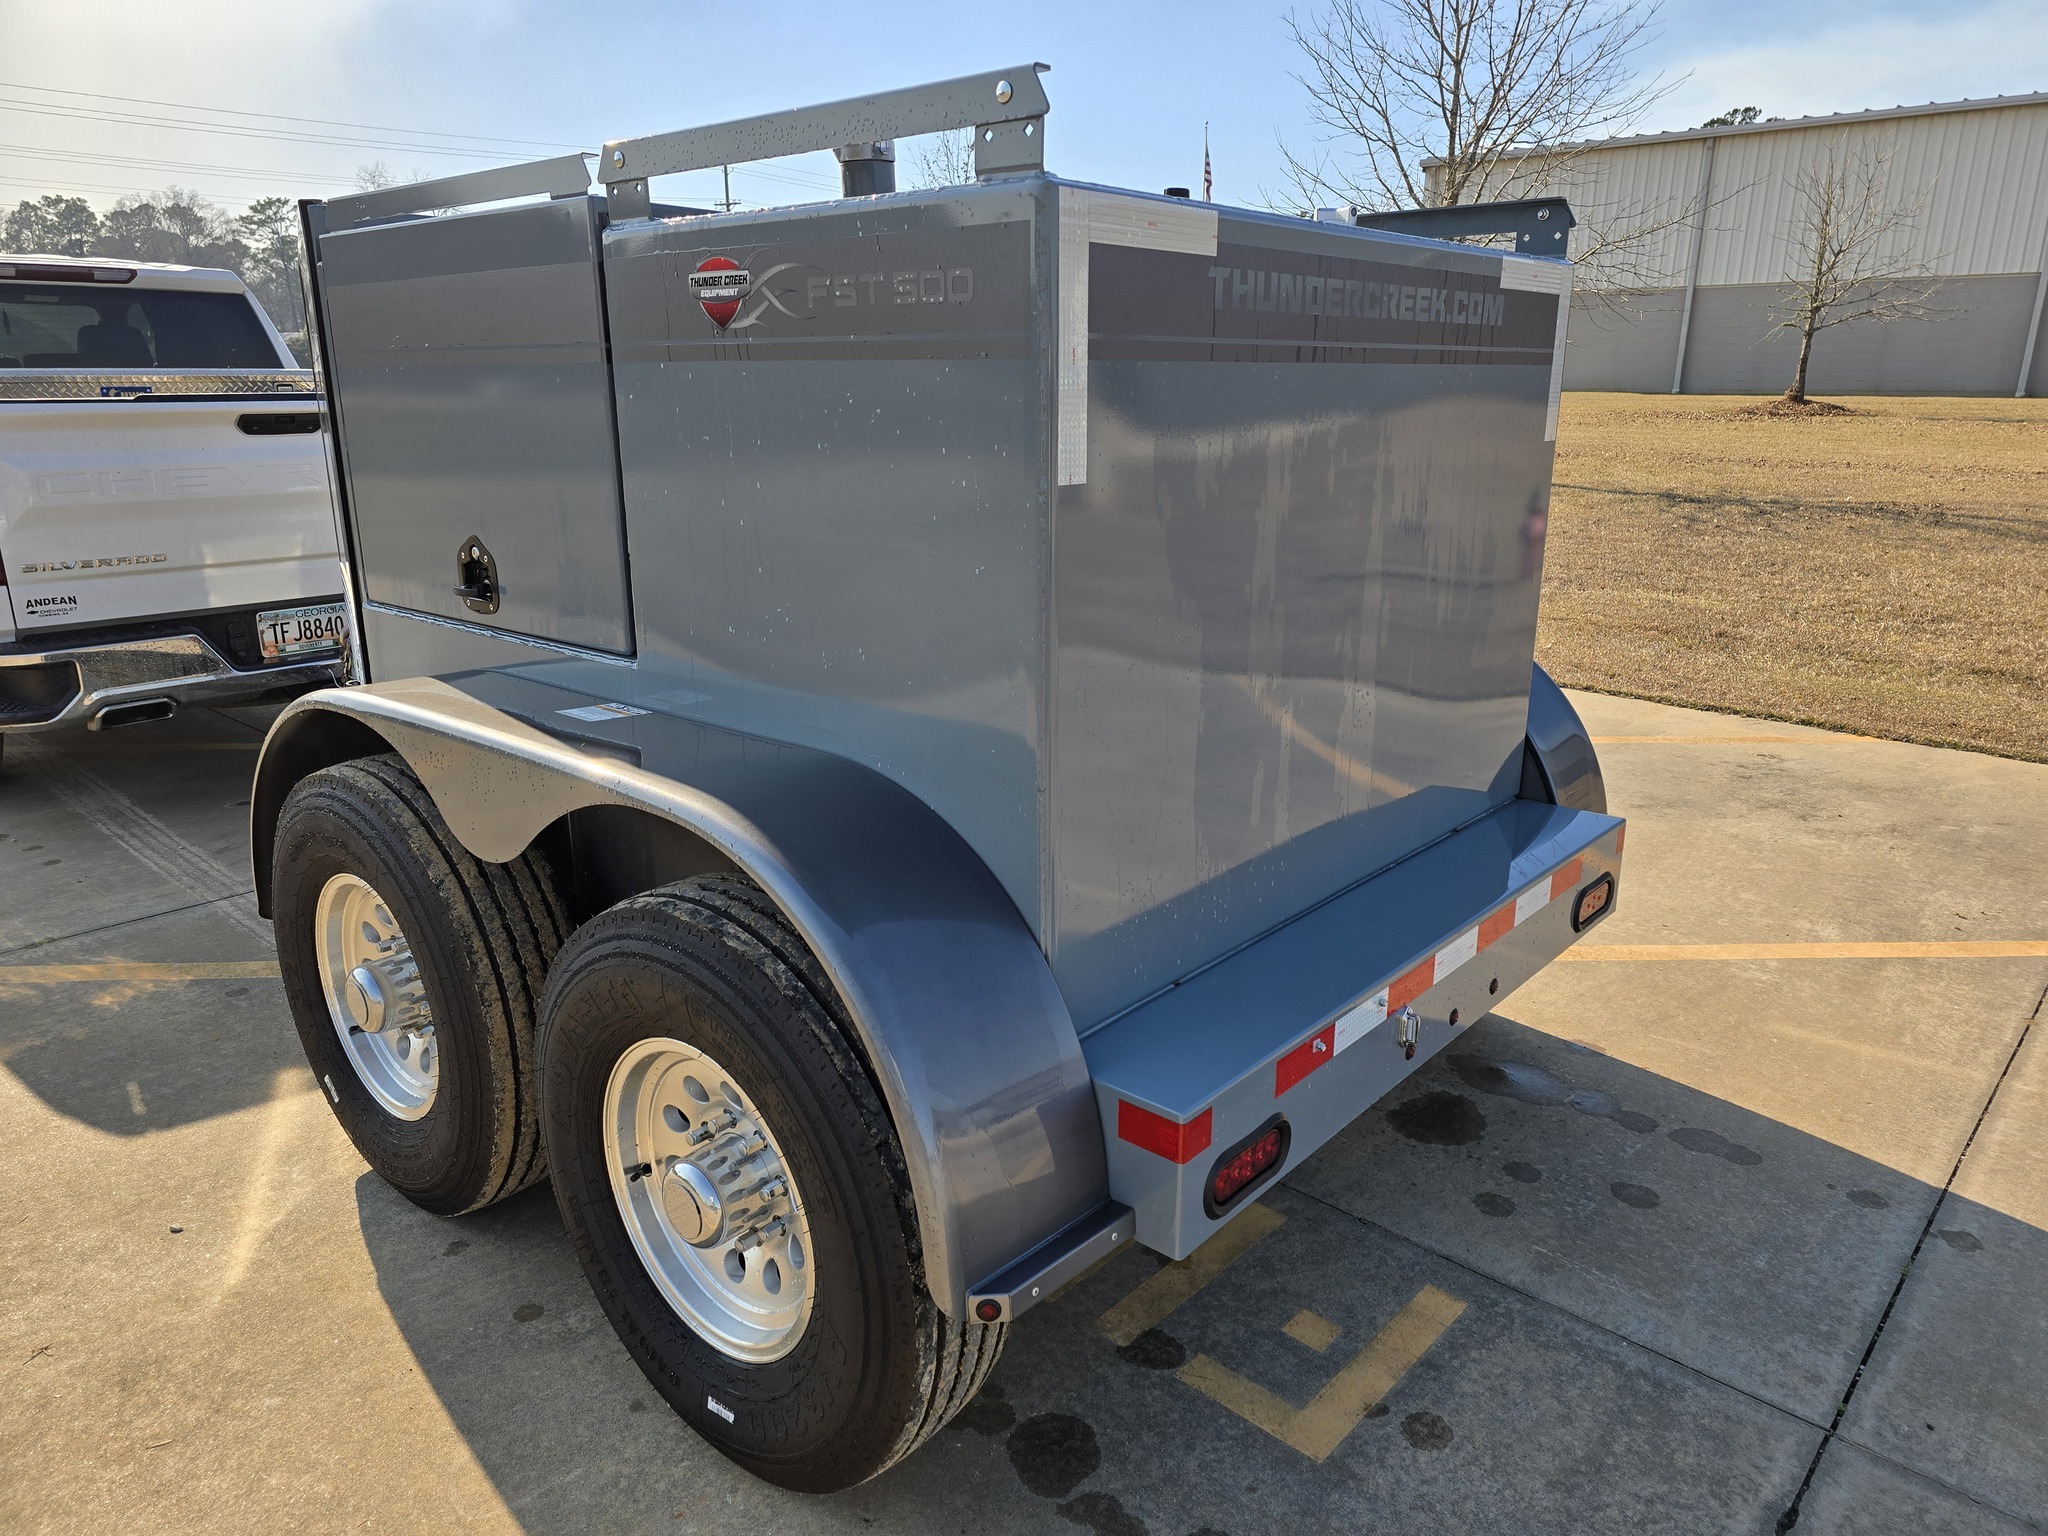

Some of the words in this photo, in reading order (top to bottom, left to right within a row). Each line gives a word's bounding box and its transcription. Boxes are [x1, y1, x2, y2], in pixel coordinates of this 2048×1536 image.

[690, 275, 723, 288] THUNDER
[724, 274, 748, 286] CREEK
[806, 271, 885, 309] FST
[891, 266, 975, 306] 500
[700, 288, 739, 298] EQUIPMENT
[1208, 265, 1505, 327] THUNDERCREEK.COM
[20, 553, 168, 574] SILVERADO
[26, 595, 78, 609] ANDEAN
[39, 606, 78, 615] CHEVROLET
[295, 604, 346, 619] GEORGIA
